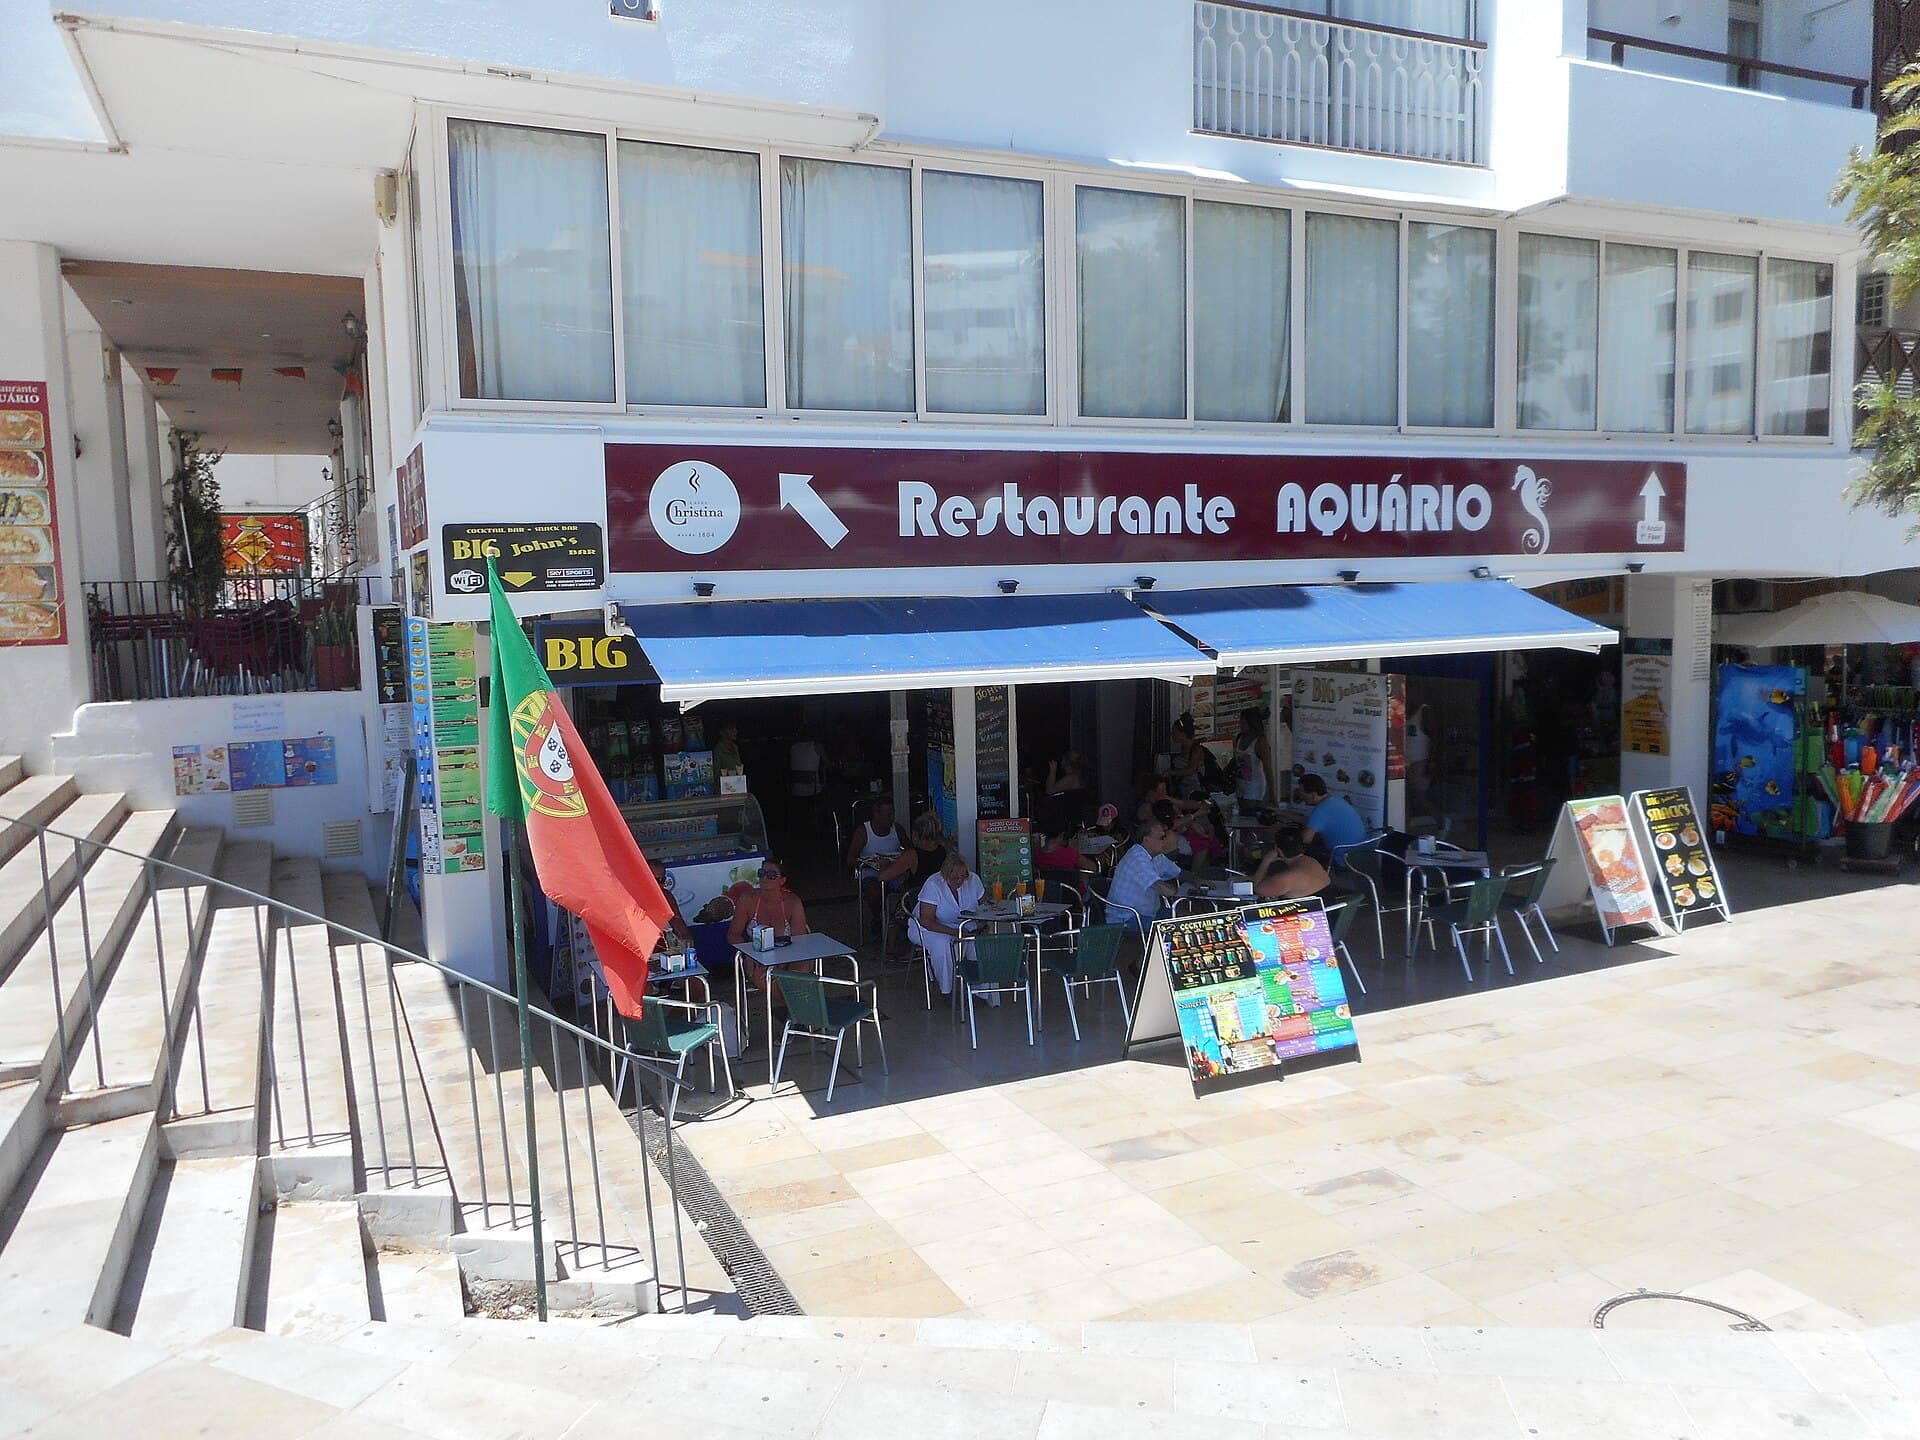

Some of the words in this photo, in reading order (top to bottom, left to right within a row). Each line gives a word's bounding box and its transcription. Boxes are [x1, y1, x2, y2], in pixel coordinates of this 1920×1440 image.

[666, 499, 724, 526] Christina
[898, 480, 1236, 537] Restaurante
[1276, 473, 1493, 537] AQUÁRIO
[451, 537, 501, 560] BIG
[510, 536, 579, 557] John's
[567, 548, 597, 556] BAR
[544, 636, 628, 671] BIG
[1311, 677, 1336, 703] BIG
[1258, 907, 1277, 919] BIG
